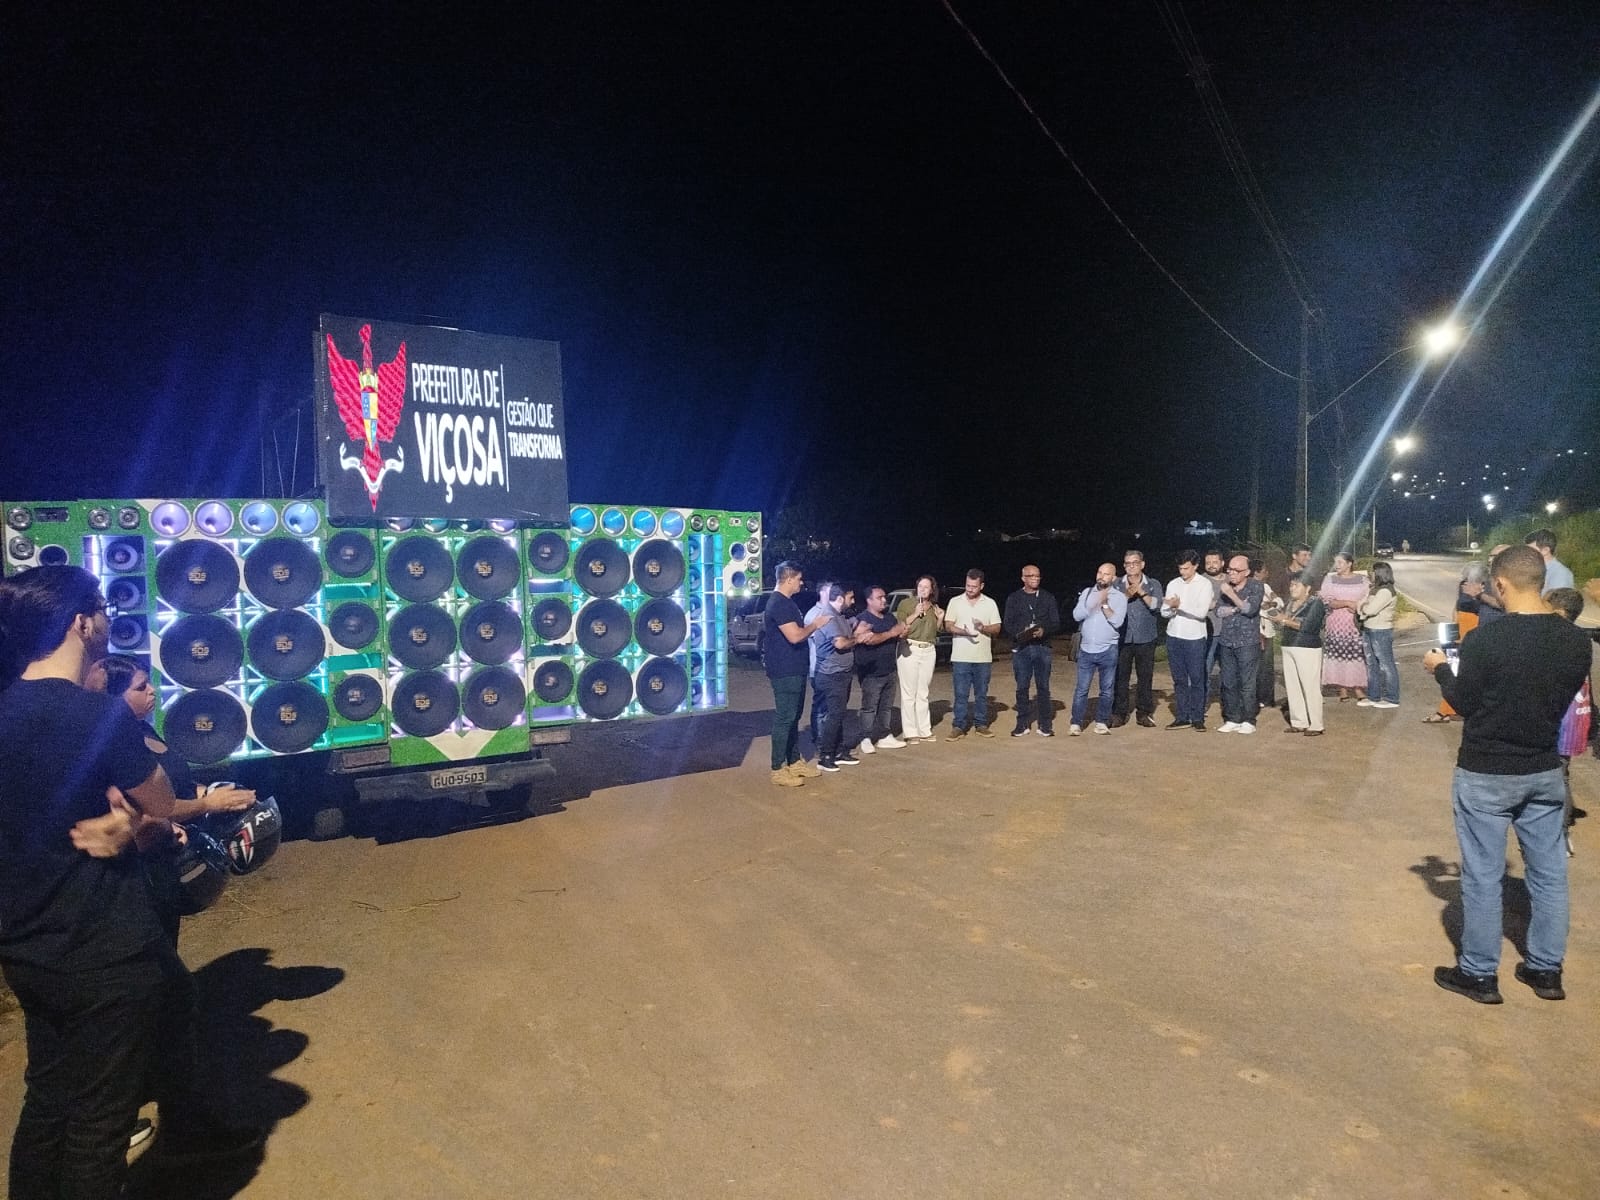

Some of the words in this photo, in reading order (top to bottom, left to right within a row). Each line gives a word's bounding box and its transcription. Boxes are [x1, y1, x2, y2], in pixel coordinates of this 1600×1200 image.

[411, 362, 483, 407] PREFEITURA
[483, 369, 501, 409] DE
[507, 397, 537, 428] GESTÃO
[537, 402, 555, 429] QUE
[414, 411, 504, 503] VIÇOSA
[508, 431, 563, 460] TRANSFORMA
